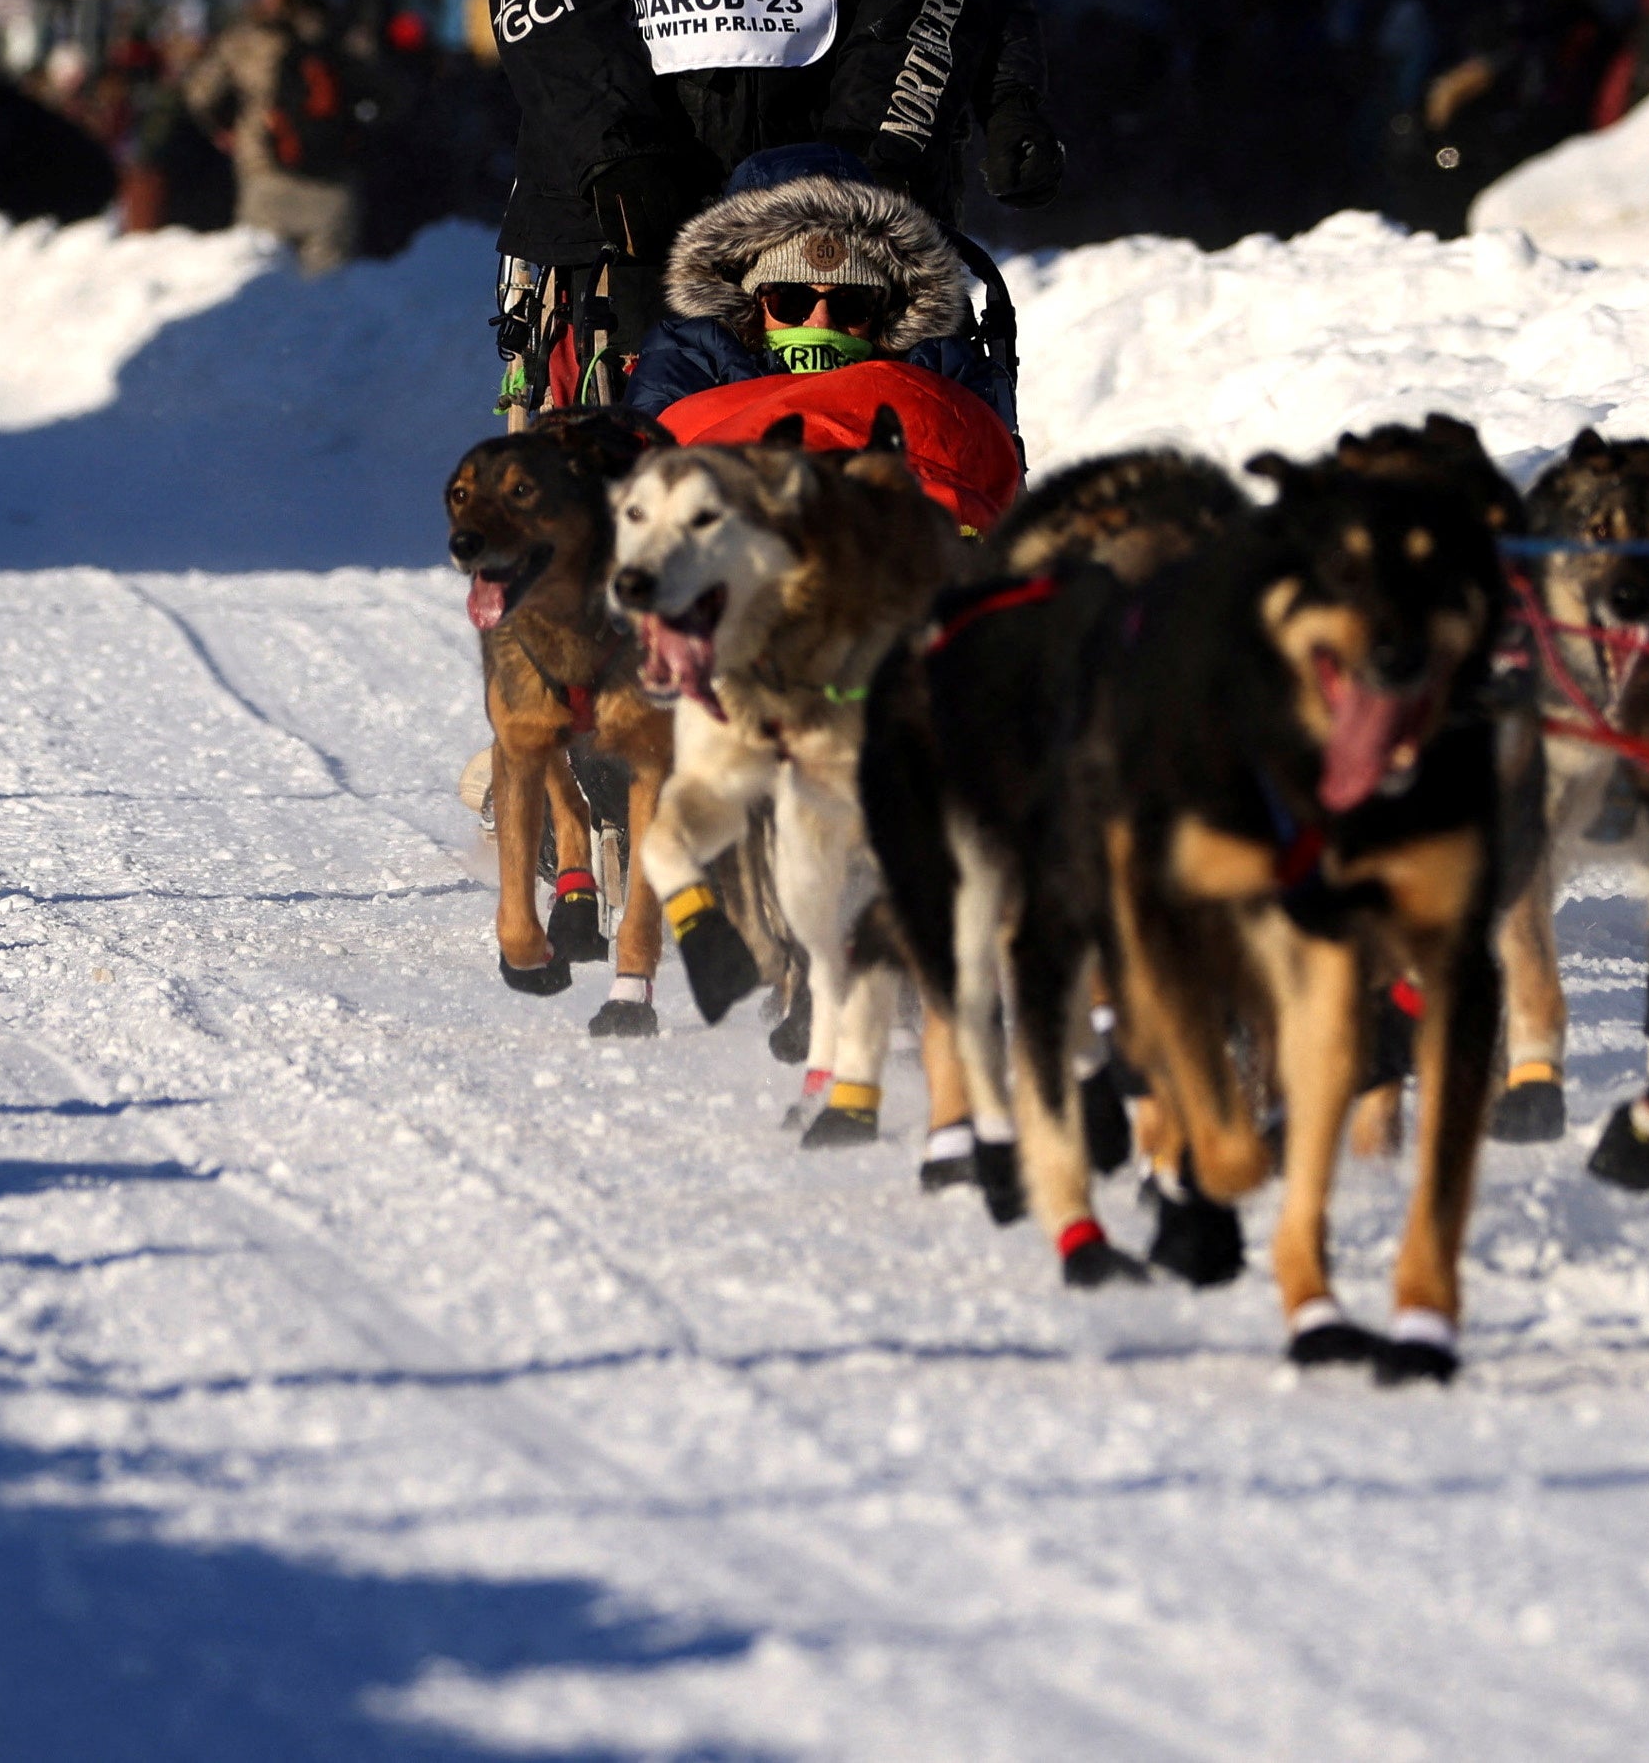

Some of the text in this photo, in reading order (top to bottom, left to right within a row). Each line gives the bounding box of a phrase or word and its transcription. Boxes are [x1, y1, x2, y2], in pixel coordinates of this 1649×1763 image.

[656, 17, 708, 38] WITH
[715, 16, 801, 34] P.R.I.D.E.
[816, 244, 835, 259] 50
